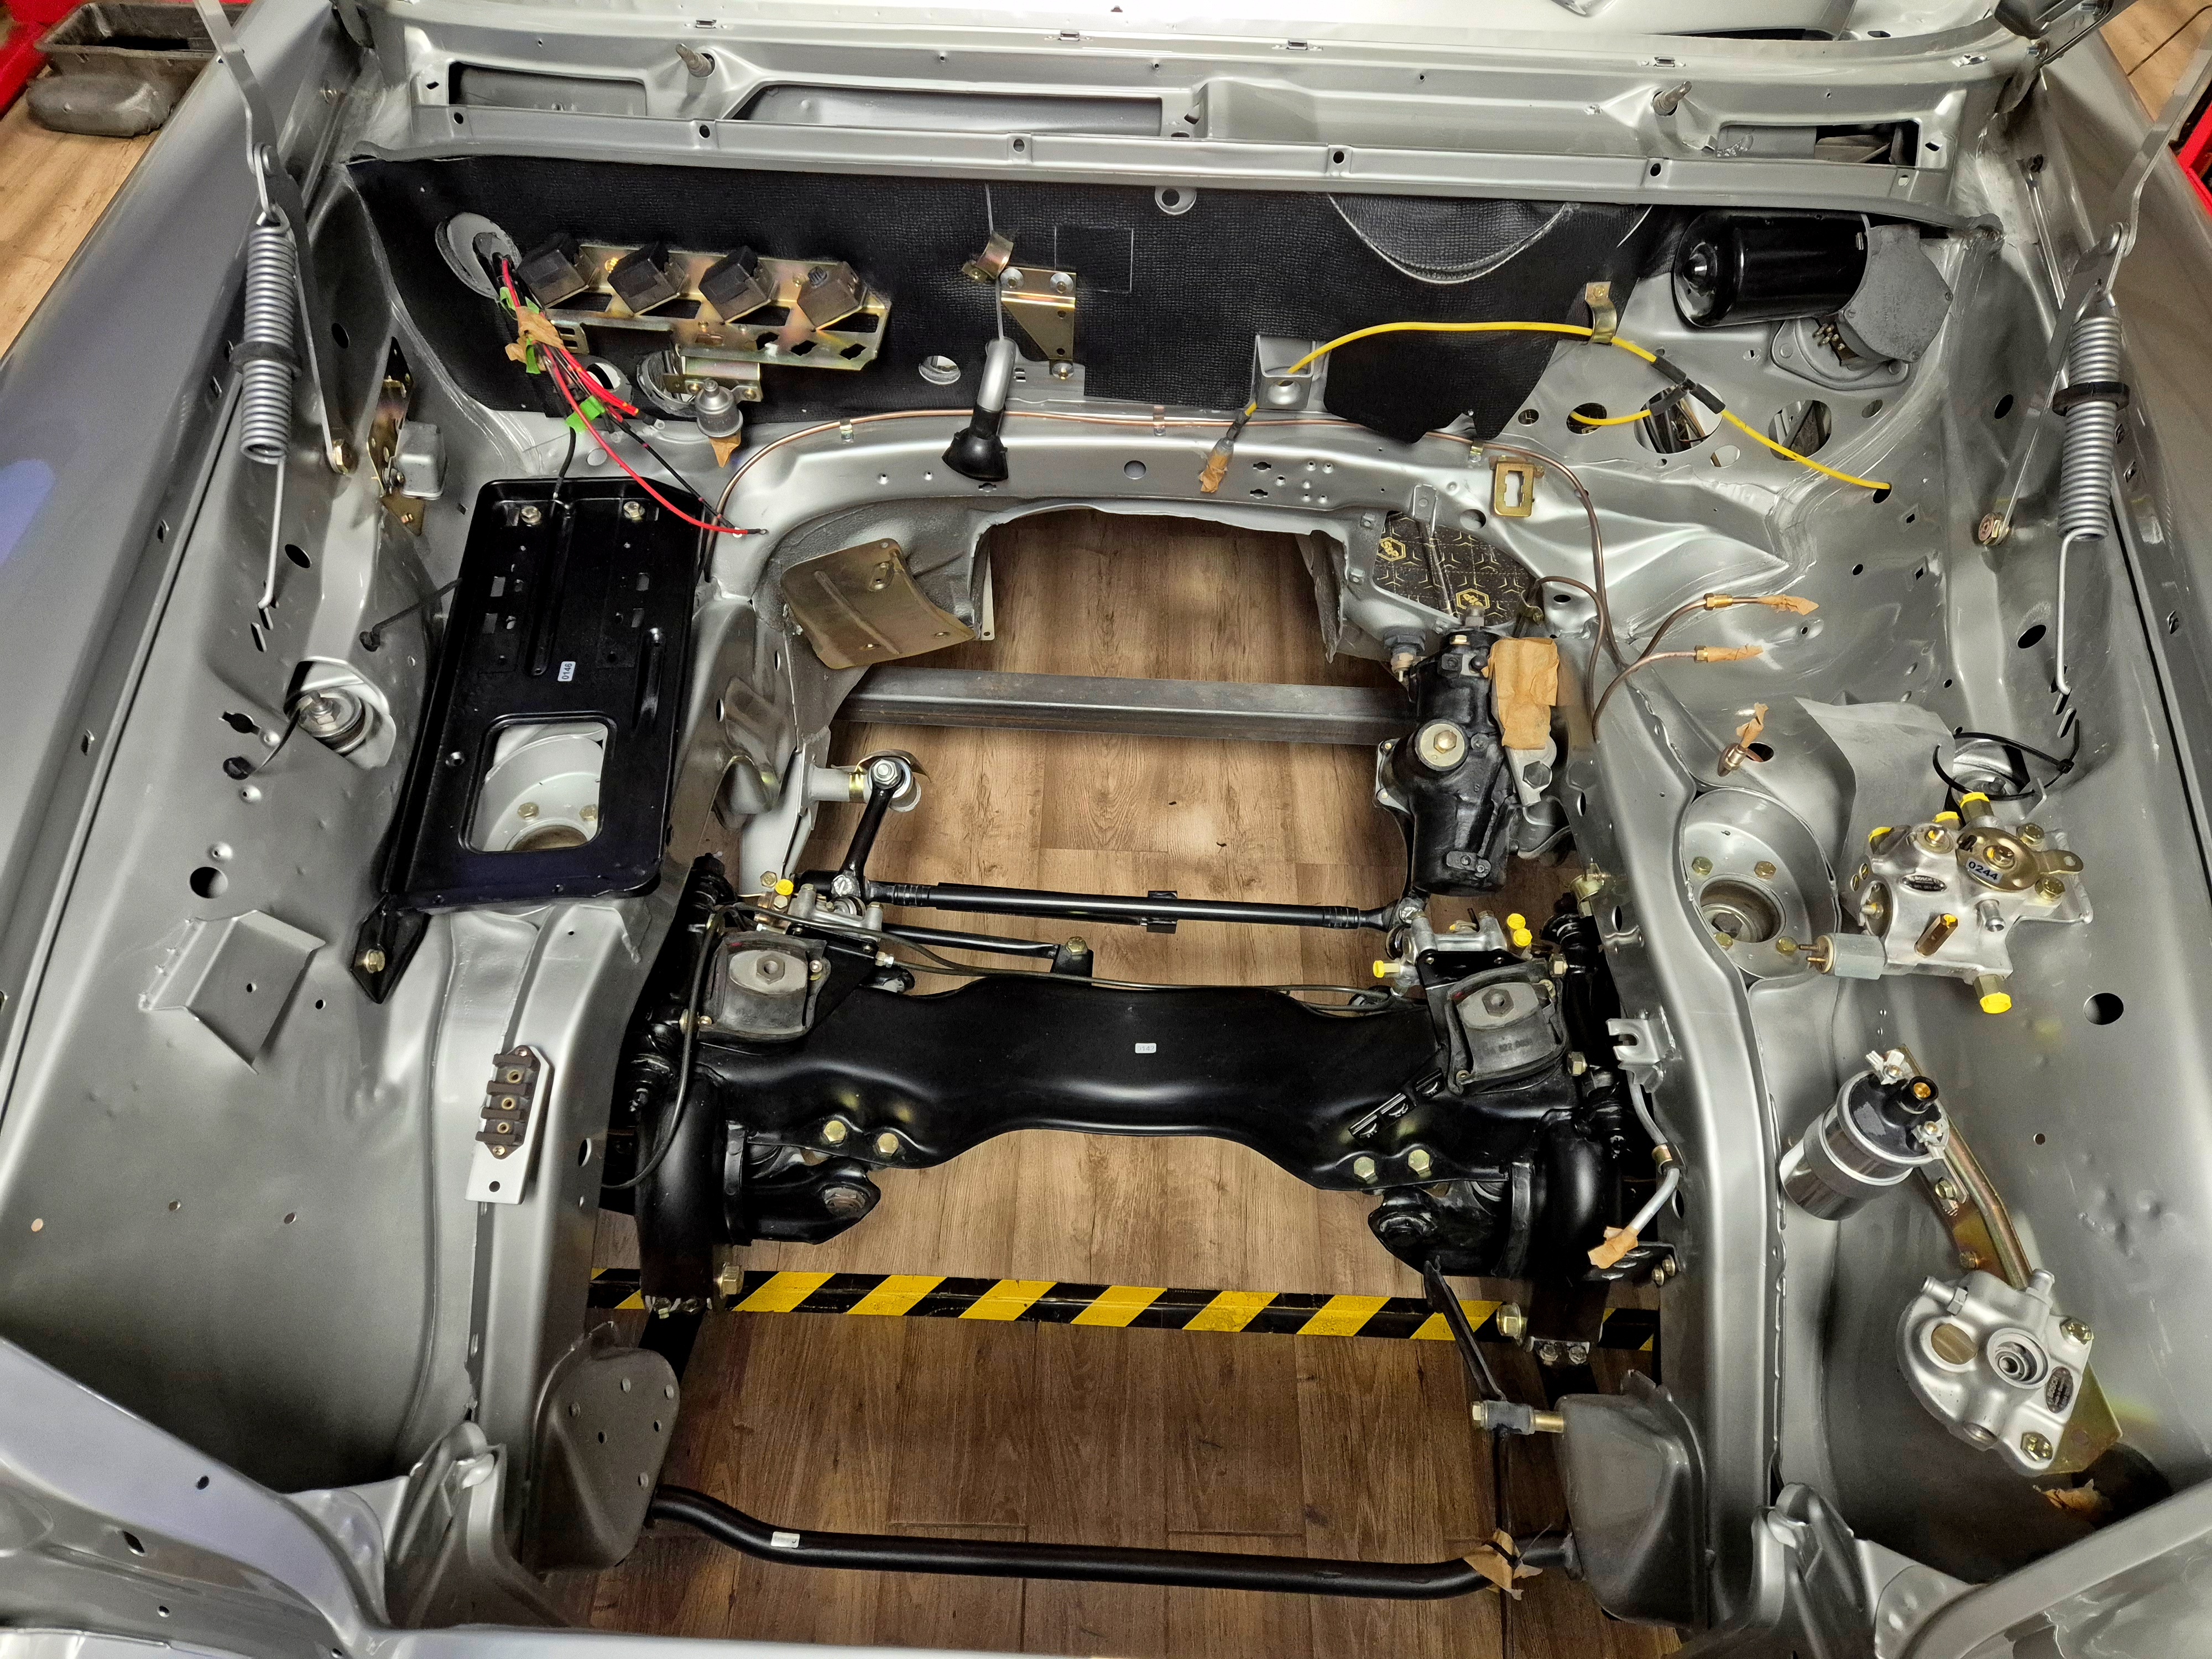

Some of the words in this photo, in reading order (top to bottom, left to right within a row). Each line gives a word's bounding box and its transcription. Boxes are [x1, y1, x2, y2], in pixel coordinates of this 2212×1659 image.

[561, 663, 572, 680] 0146
[1969, 861, 1998, 880] 0244
[2047, 1375, 2059, 1399] BOSCH
